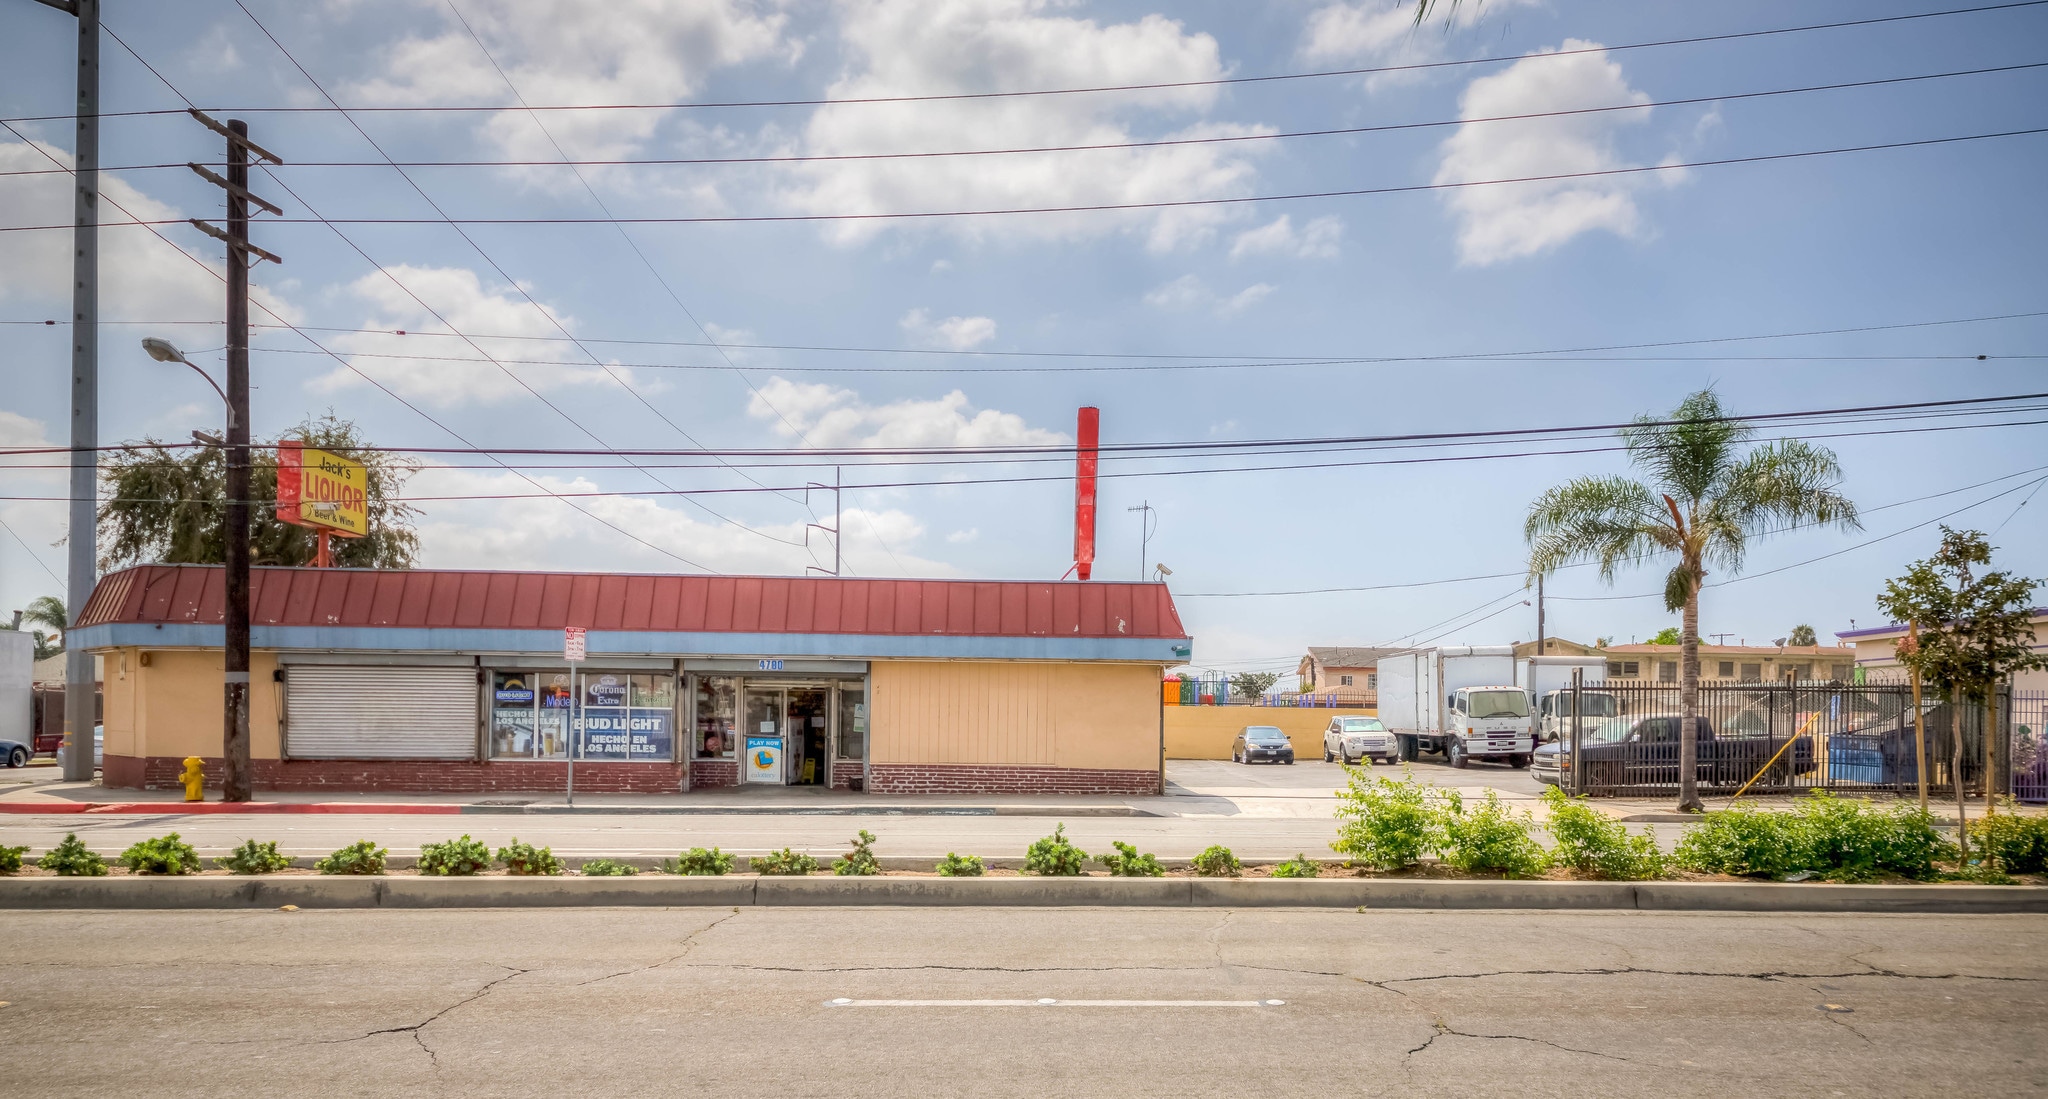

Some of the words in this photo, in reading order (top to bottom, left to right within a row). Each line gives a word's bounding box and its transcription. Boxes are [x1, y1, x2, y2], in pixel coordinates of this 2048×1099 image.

[320, 457, 351, 479] Jack's
[306, 472, 363, 514] LIQUOR
[314, 509, 330, 521] Beer
[332, 513, 337, 522] &
[339, 515, 354, 527] Wine
[759, 660, 783, 670] 4780
[589, 683, 626, 696] Corona
[597, 696, 619, 705] Extra
[496, 710, 527, 718] HECHO
[574, 718, 611, 730] BUD
[613, 718, 661, 730] LIGHT
[592, 735, 629, 744] HECHO
[633, 736, 647, 744] EN
[578, 743, 603, 753] LOS
[605, 744, 656, 753] ANGELES
